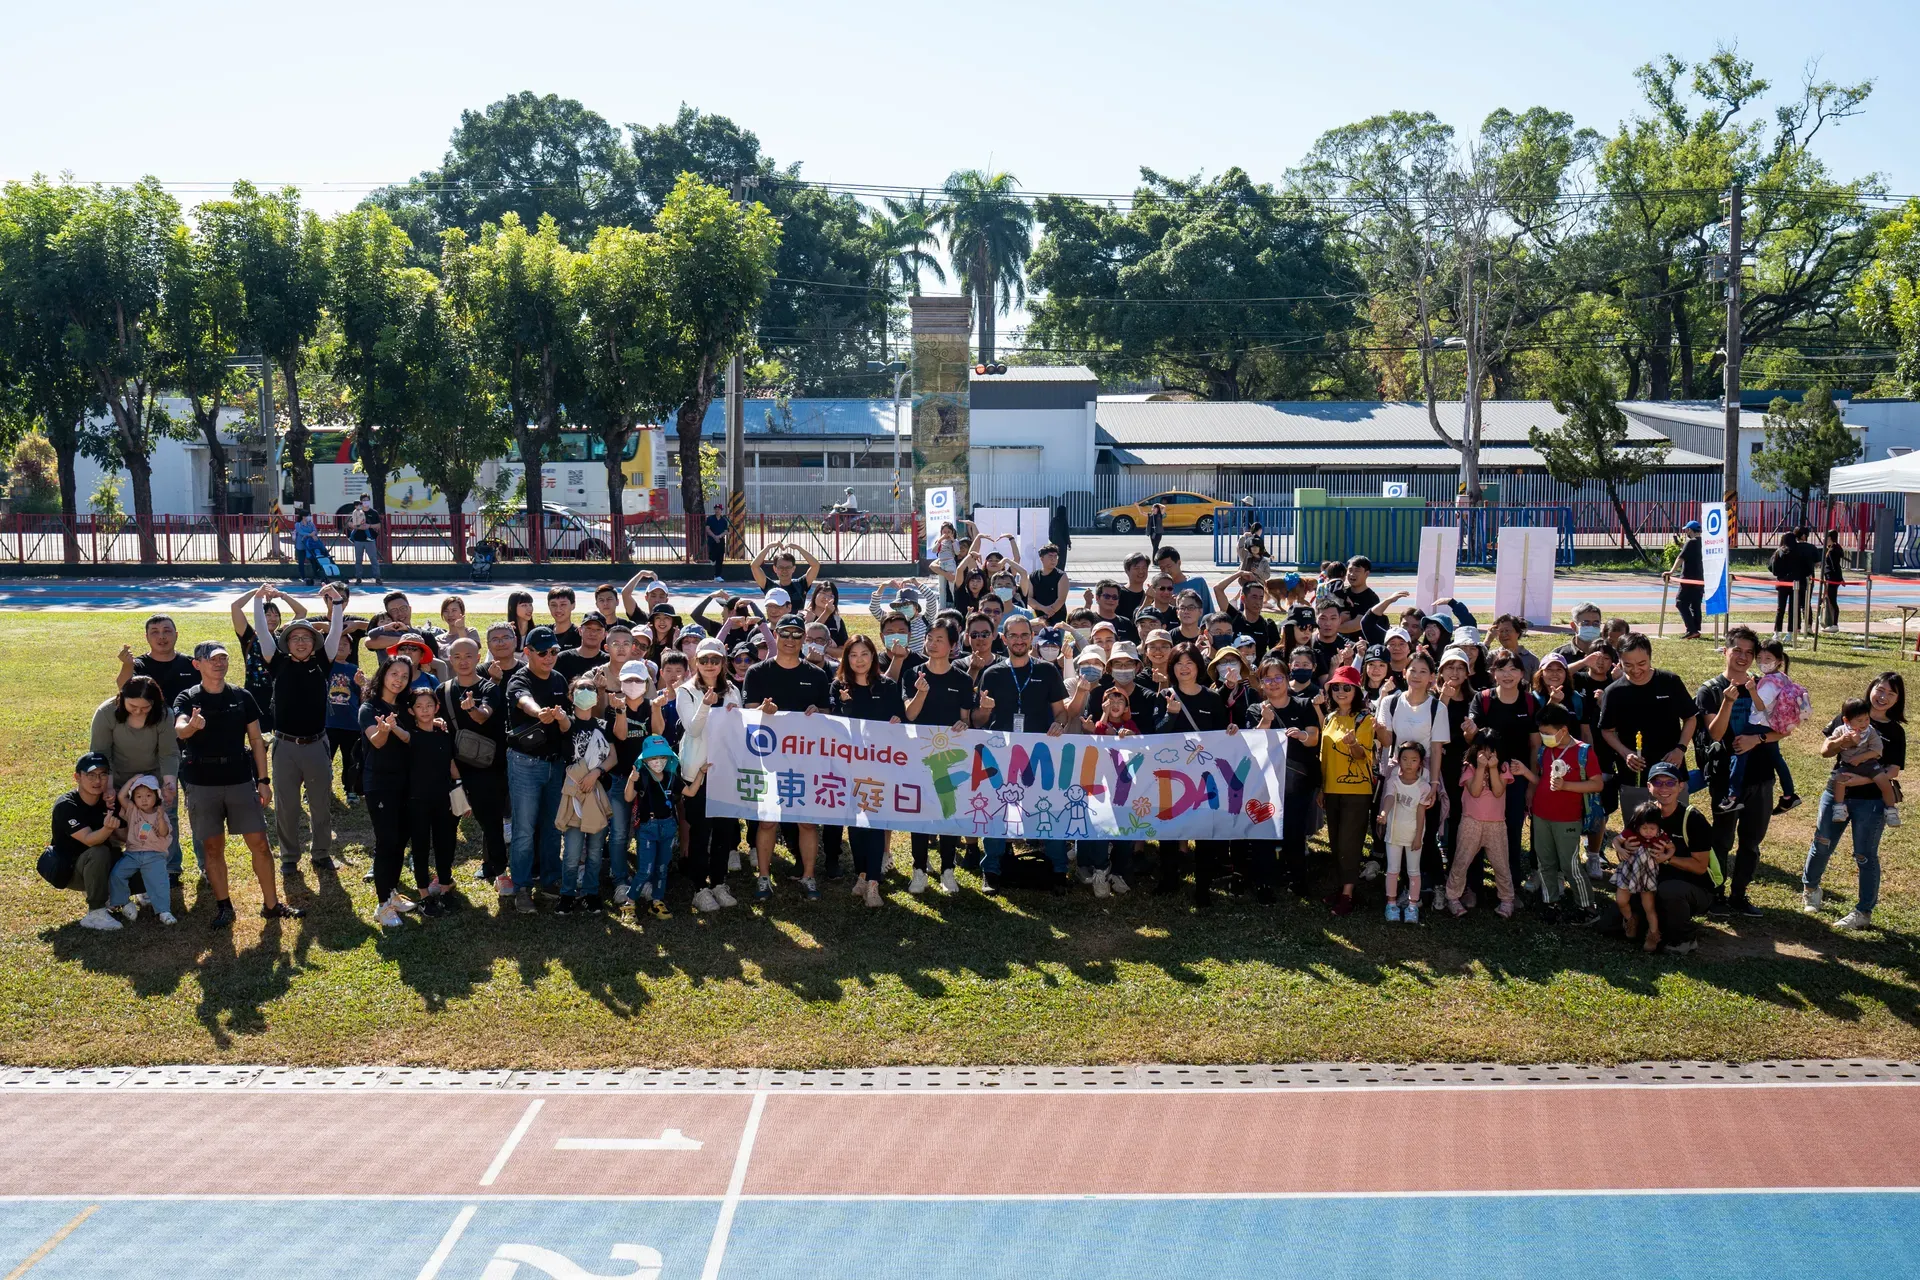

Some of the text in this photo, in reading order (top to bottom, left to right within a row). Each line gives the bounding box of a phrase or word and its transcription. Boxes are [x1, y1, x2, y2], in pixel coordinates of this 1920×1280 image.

[781, 735, 908, 766] Air Liquide
[736, 768, 922, 814] 亞東家庭日
[921, 741, 1252, 821] FAMILY DAY
[553, 1128, 704, 1151] 1
